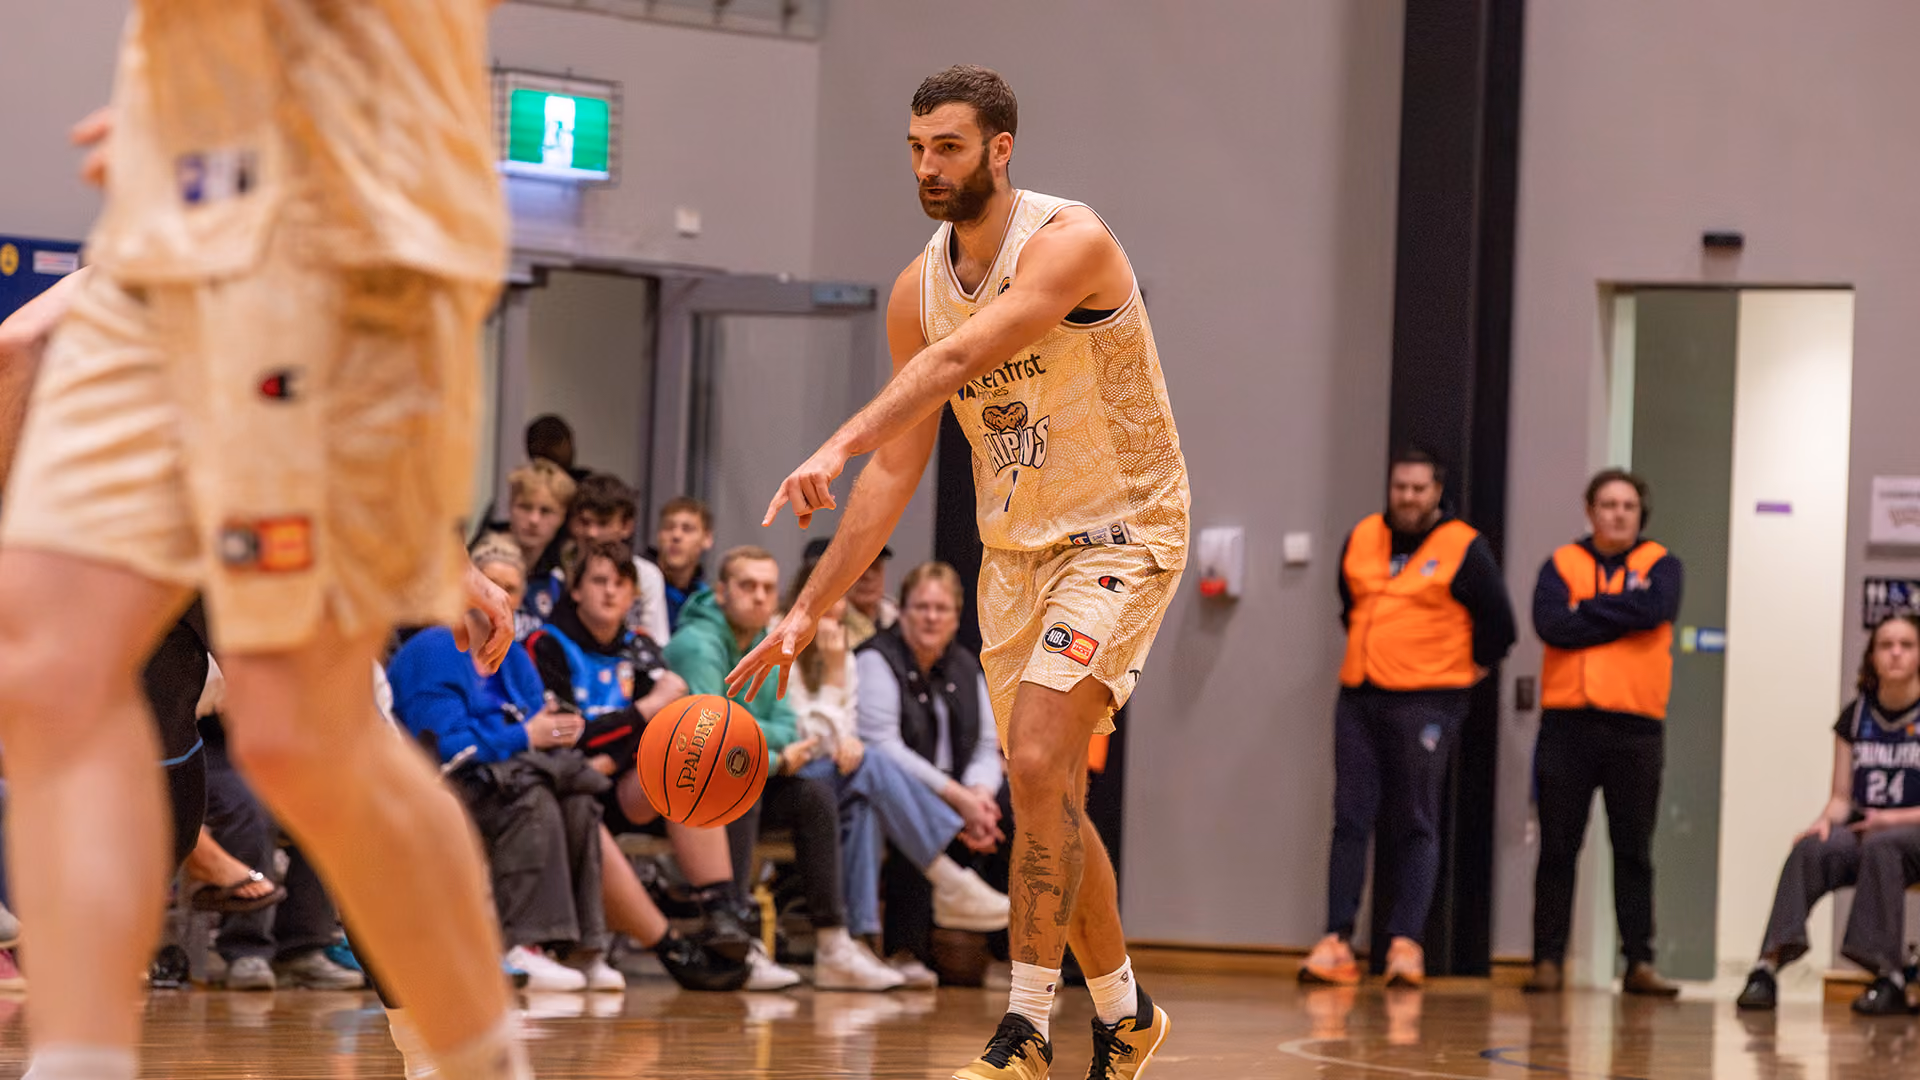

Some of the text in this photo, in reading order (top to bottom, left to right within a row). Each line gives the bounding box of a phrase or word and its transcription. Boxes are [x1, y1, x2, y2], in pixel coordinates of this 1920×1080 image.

[1047, 629, 1067, 647] NBL
[675, 707, 722, 794] SPALDING
[1866, 769, 1905, 805] 24
